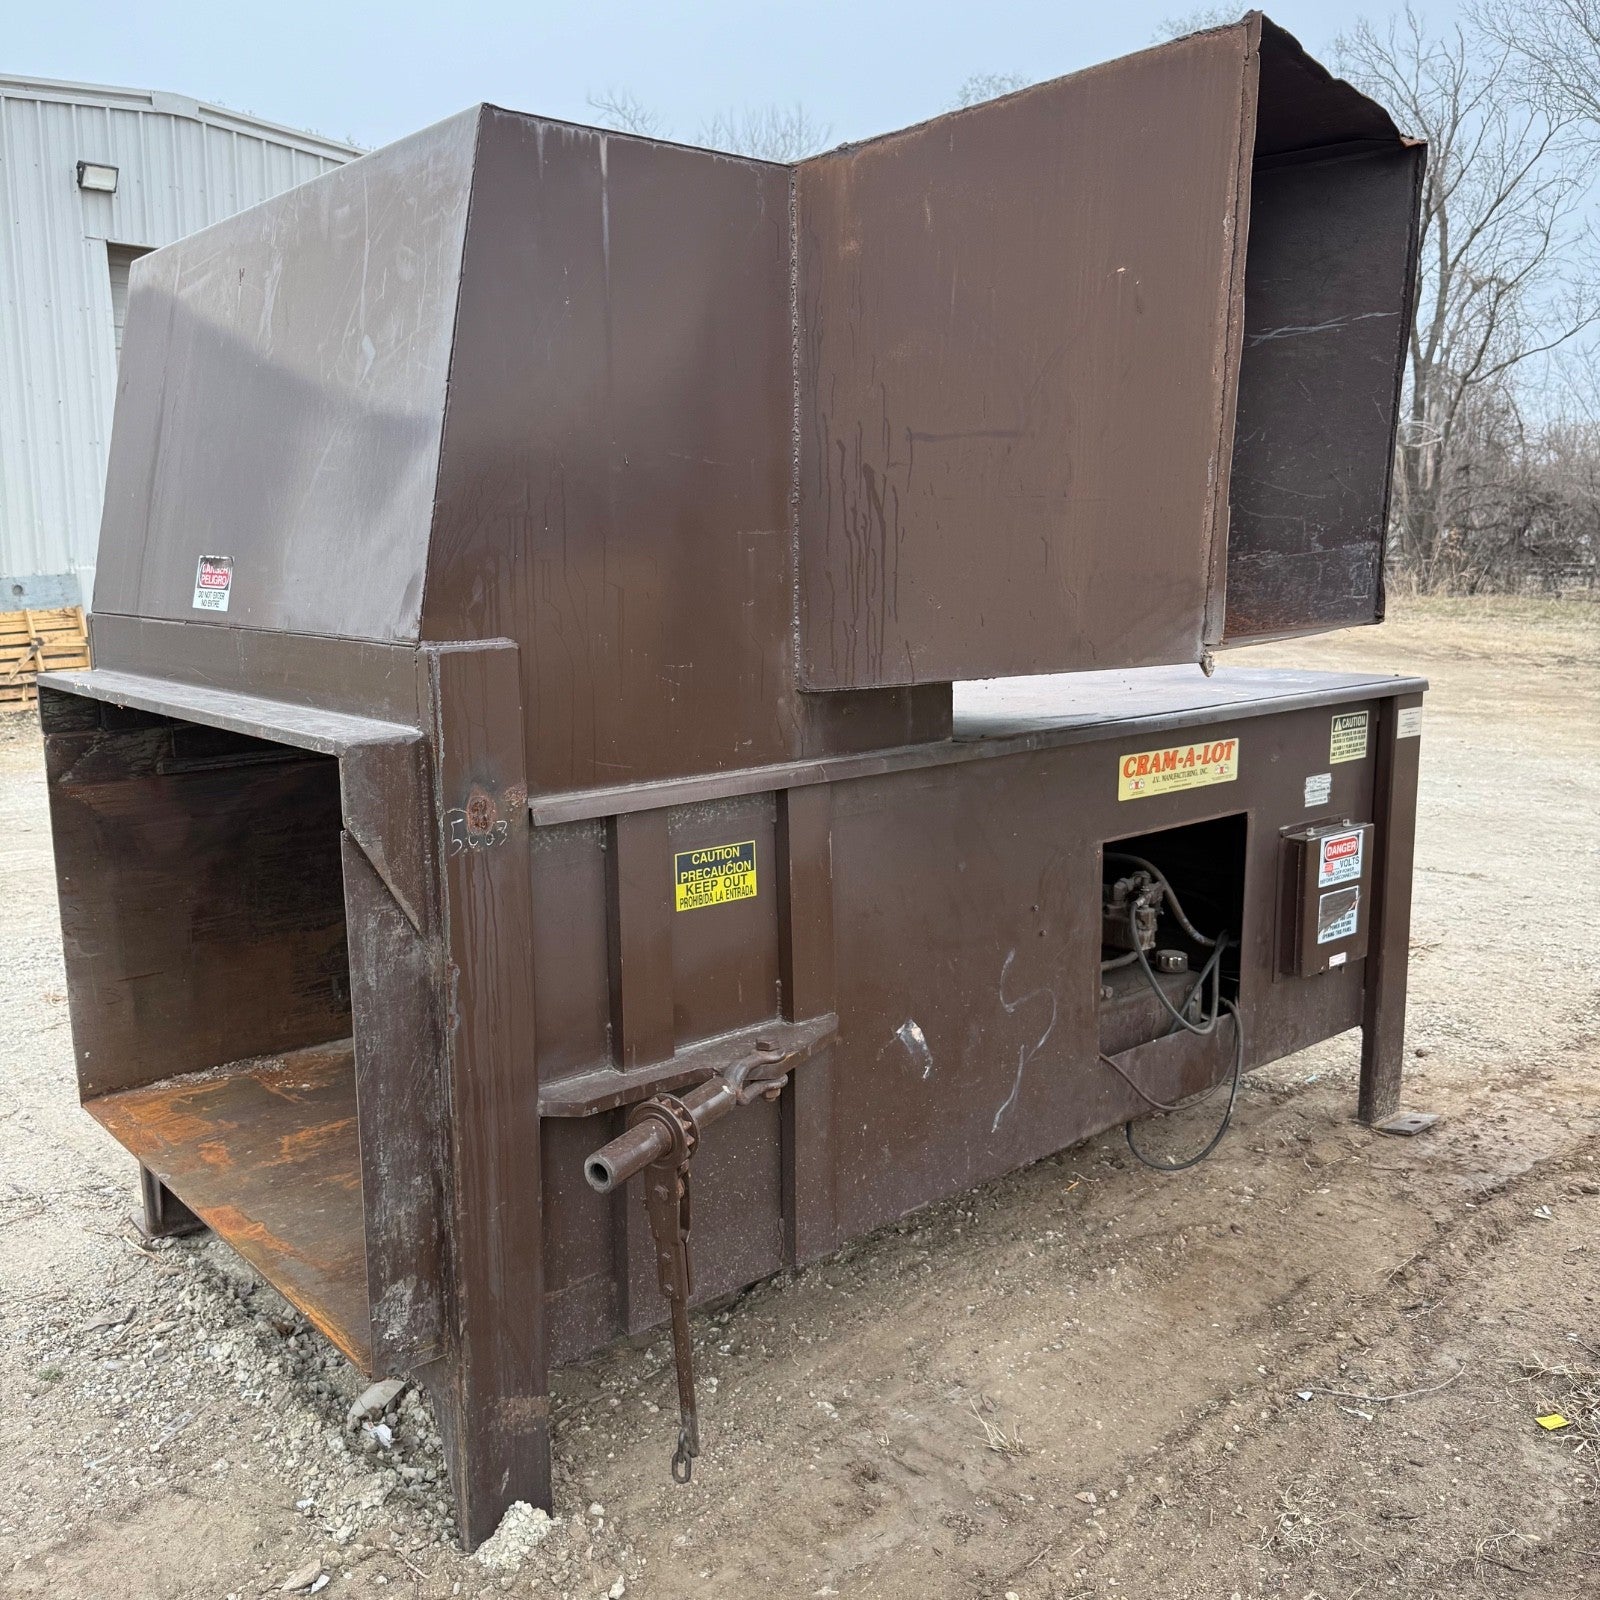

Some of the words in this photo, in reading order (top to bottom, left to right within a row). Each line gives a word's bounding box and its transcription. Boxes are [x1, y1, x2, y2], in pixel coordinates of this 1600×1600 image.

[202, 574, 227, 586] PELIGRO
[1342, 715, 1366, 729] CAUTION
[692, 846, 740, 865] CAUTION
[1326, 841, 1357, 857] DANGER
[1340, 856, 1360, 868] VOLTS
[686, 879, 718, 896] KEEP
[723, 874, 748, 889] OUT
[680, 892, 713, 909] PROHIBIDA
[715, 890, 724, 902] LA
[725, 884, 754, 900] ENTRADA
